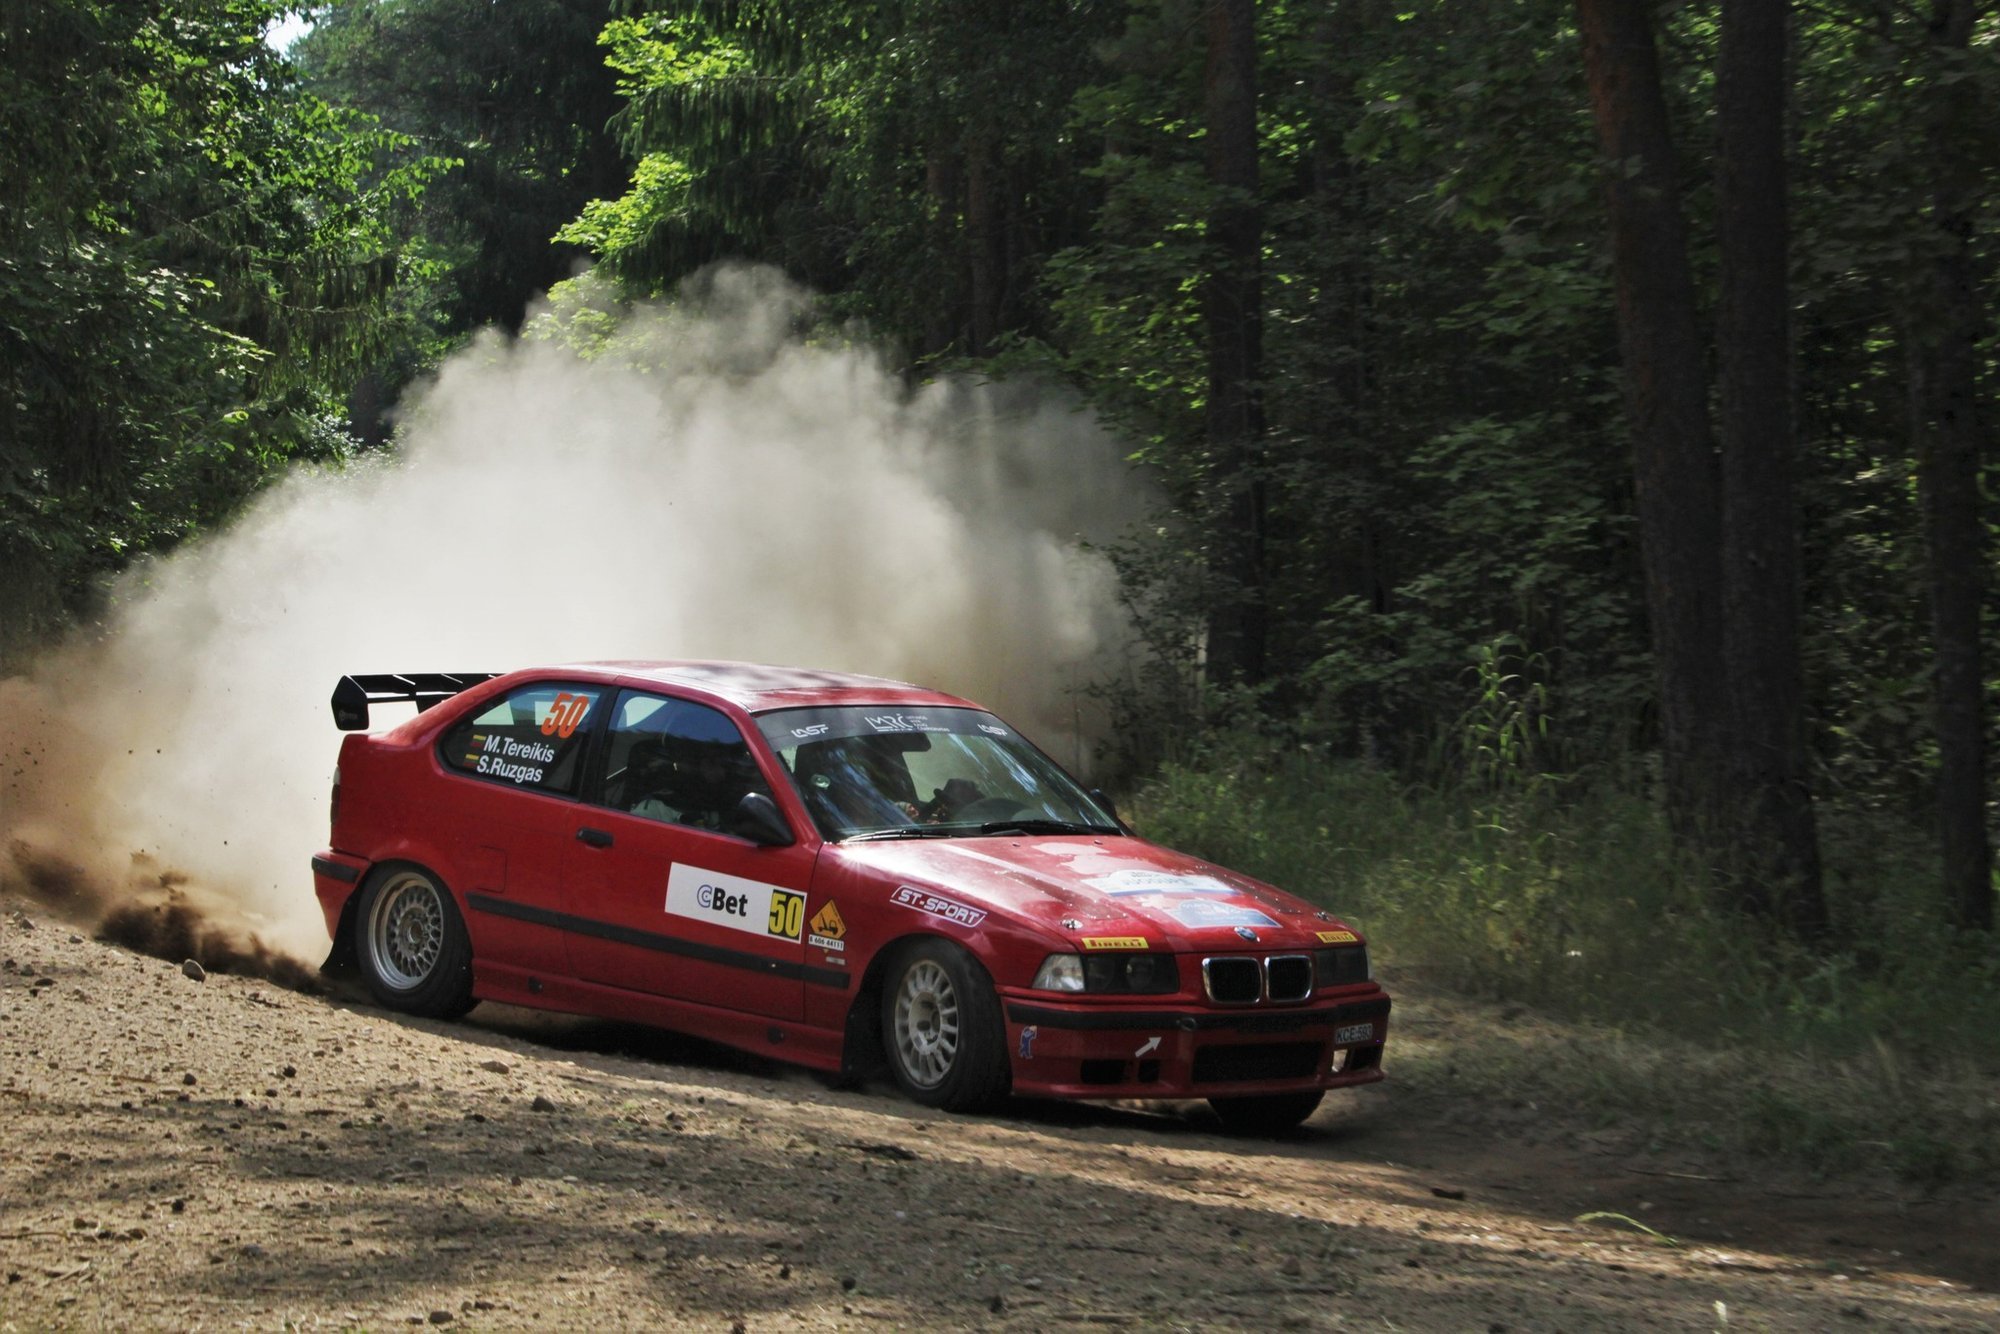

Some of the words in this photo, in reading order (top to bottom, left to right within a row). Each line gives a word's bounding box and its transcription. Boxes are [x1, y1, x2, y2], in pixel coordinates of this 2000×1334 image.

[540, 691, 590, 739] 50
[483, 734, 555, 763] M.Tereikis
[476, 755, 543, 784] S.Ruzgas
[769, 892, 803, 938] 50
[1089, 939, 1142, 947] PIRELLI
